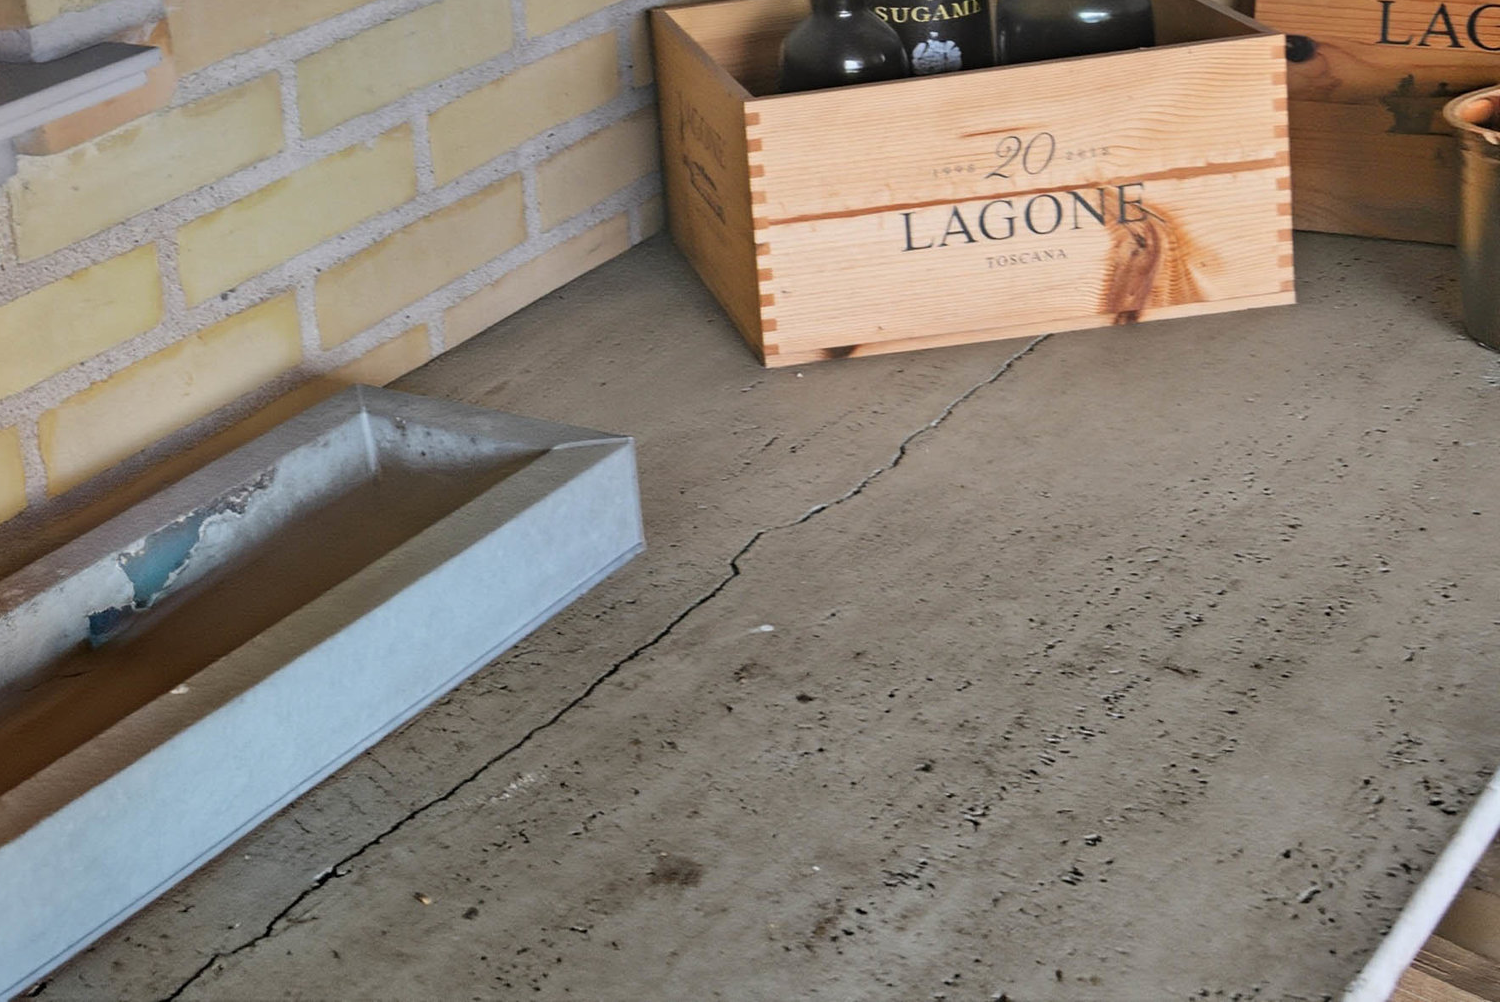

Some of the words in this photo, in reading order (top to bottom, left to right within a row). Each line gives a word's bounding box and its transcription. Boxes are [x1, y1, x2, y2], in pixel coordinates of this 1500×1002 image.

[983, 131, 1056, 179] 20
[900, 182, 1148, 252] LAGONE
[985, 248, 1068, 269] TOSCANA
